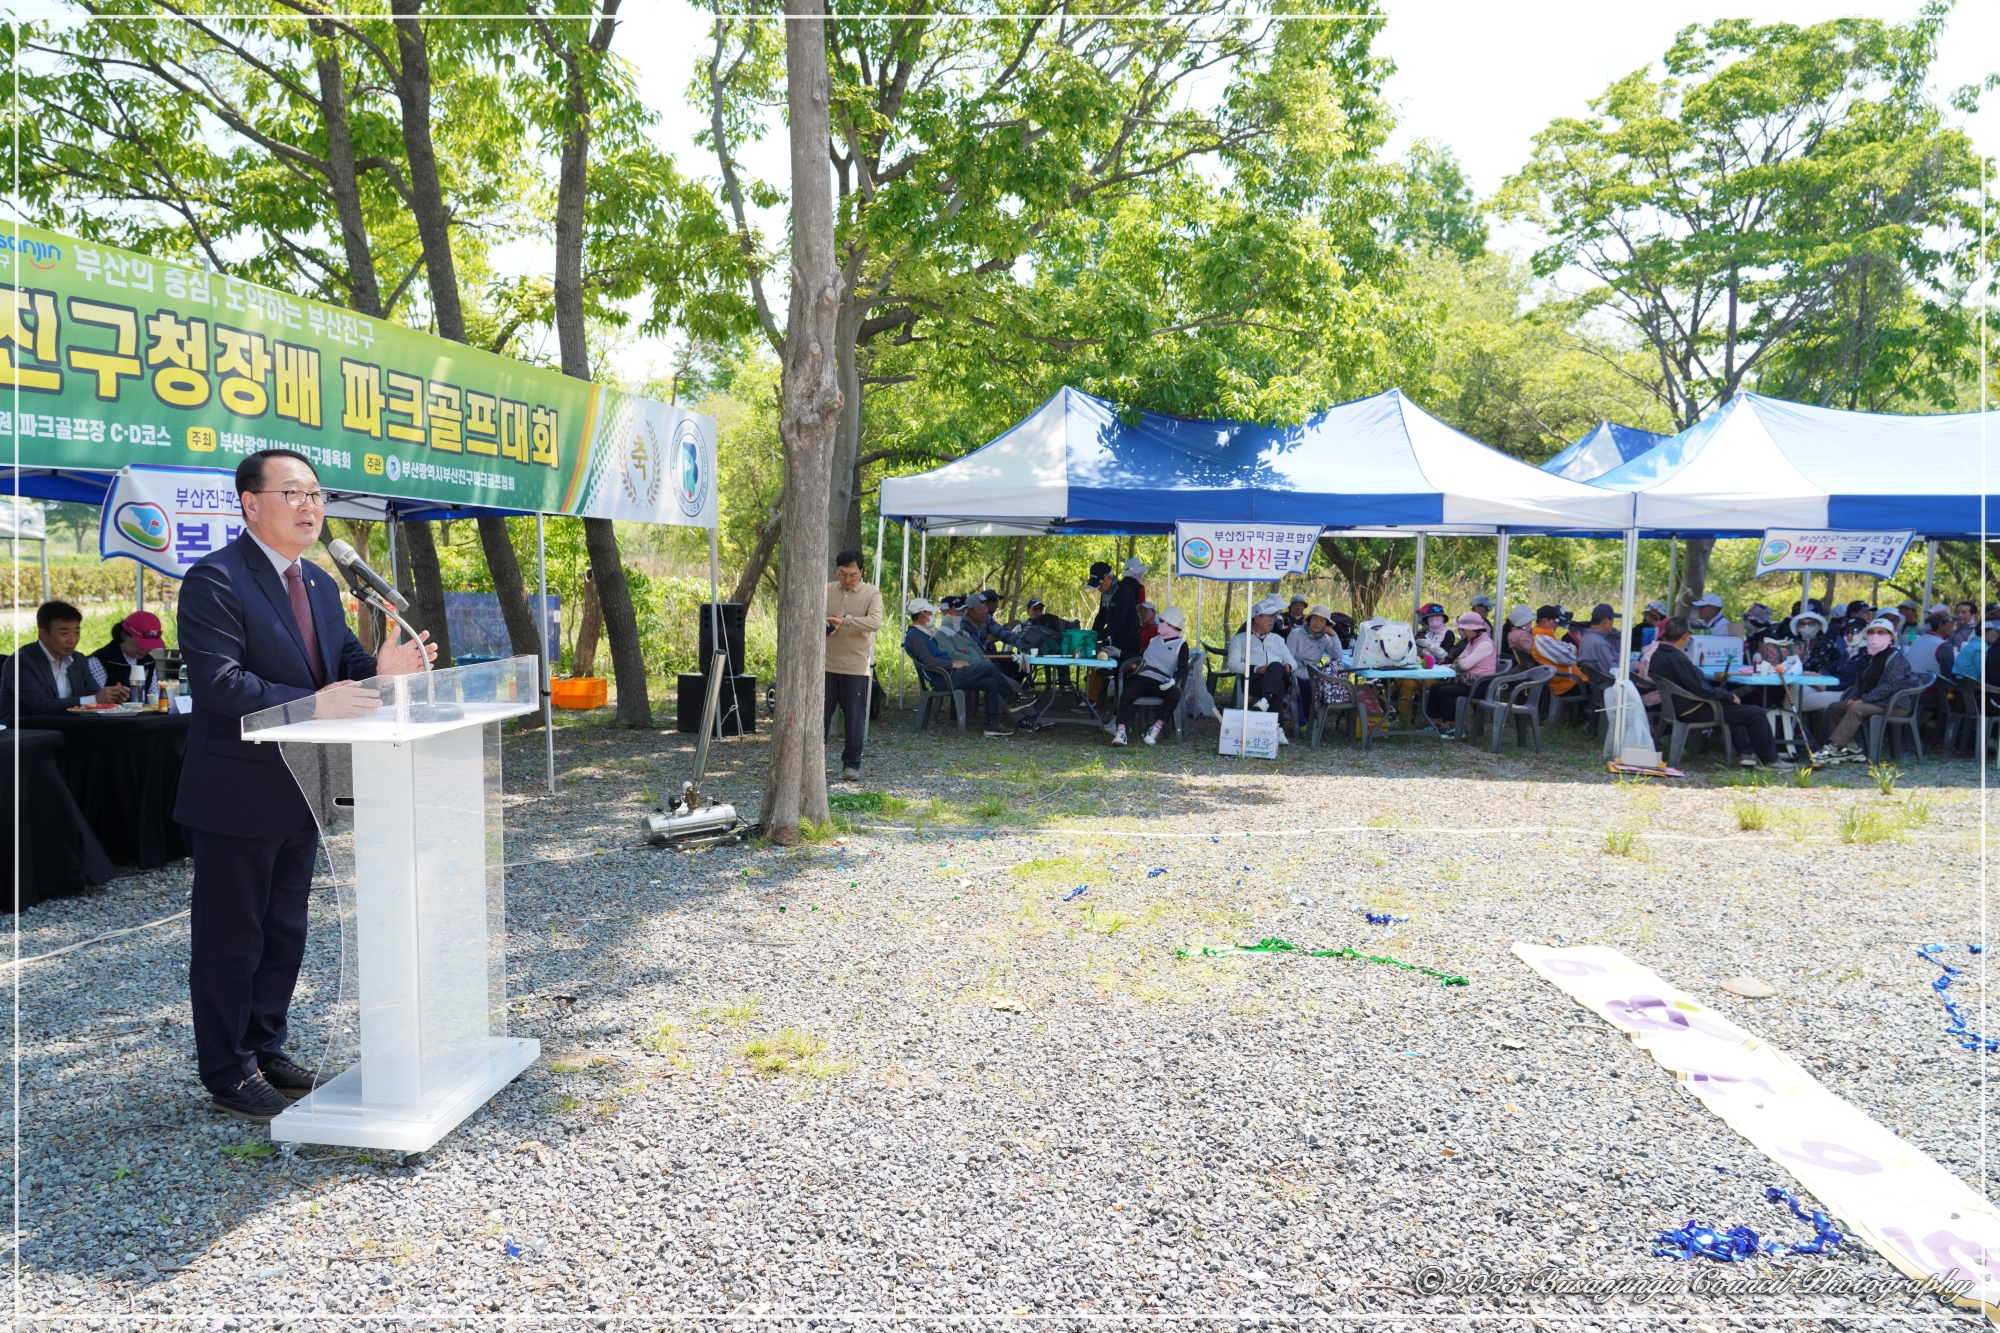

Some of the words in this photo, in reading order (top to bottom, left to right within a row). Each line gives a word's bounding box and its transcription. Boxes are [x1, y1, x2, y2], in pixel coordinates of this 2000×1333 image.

[73, 243, 155, 293] 부산의
[164, 265, 218, 308] 중심,
[225, 278, 303, 331] 도약하는
[308, 304, 375, 350] 부산진구
[0, 282, 324, 434] 진구청장배
[340, 356, 562, 472] 파크골프대회
[19, 412, 107, 443] 파크골프장
[192, 431, 212, 447] 주최
[367, 457, 381, 471] 주관
[402, 460, 515, 491] 부산광역시부산진구파크골프협회
[630, 434, 649, 482] 축
[1214, 530, 1316, 544] 부산진구파크골프협회
[1794, 545, 1894, 567] 백조클럽
